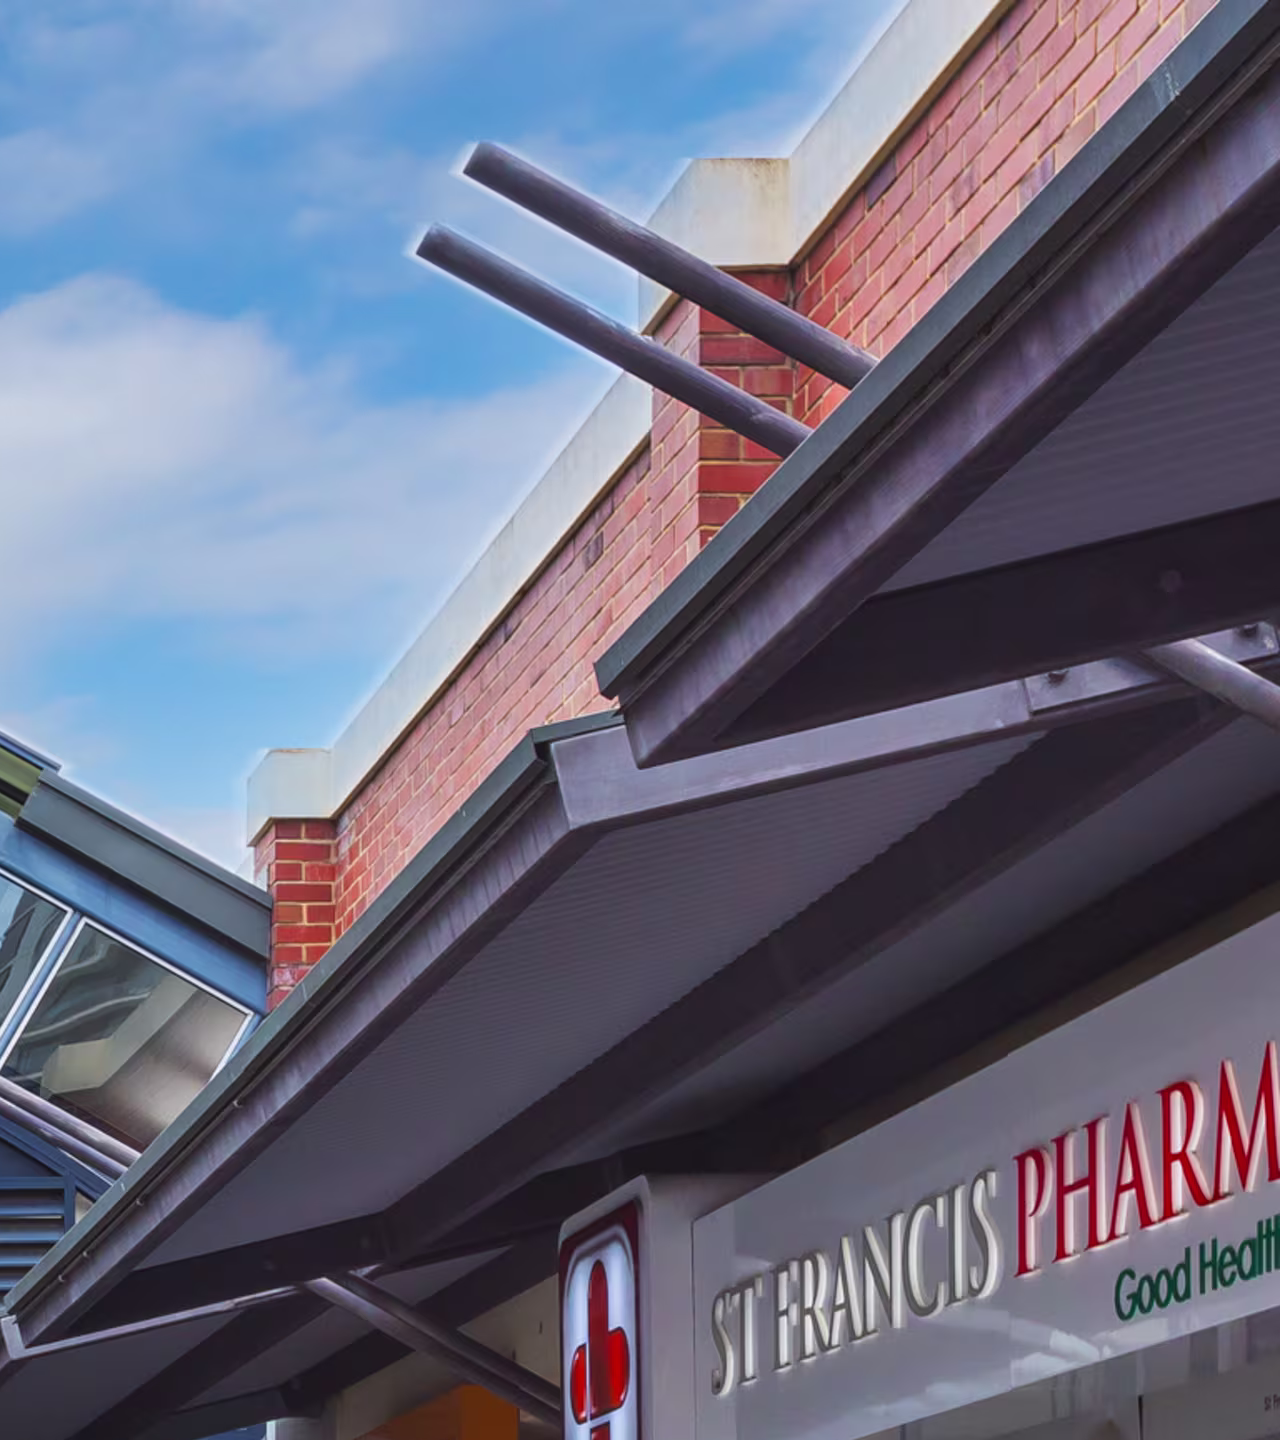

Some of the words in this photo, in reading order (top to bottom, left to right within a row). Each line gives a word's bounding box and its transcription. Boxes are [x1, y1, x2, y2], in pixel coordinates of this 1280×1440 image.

[711, 1272, 763, 1396] ST
[770, 1168, 1002, 1374] FRANCIS
[1012, 1039, 1280, 1278] PHARM
[1114, 1246, 1191, 1322] Good
